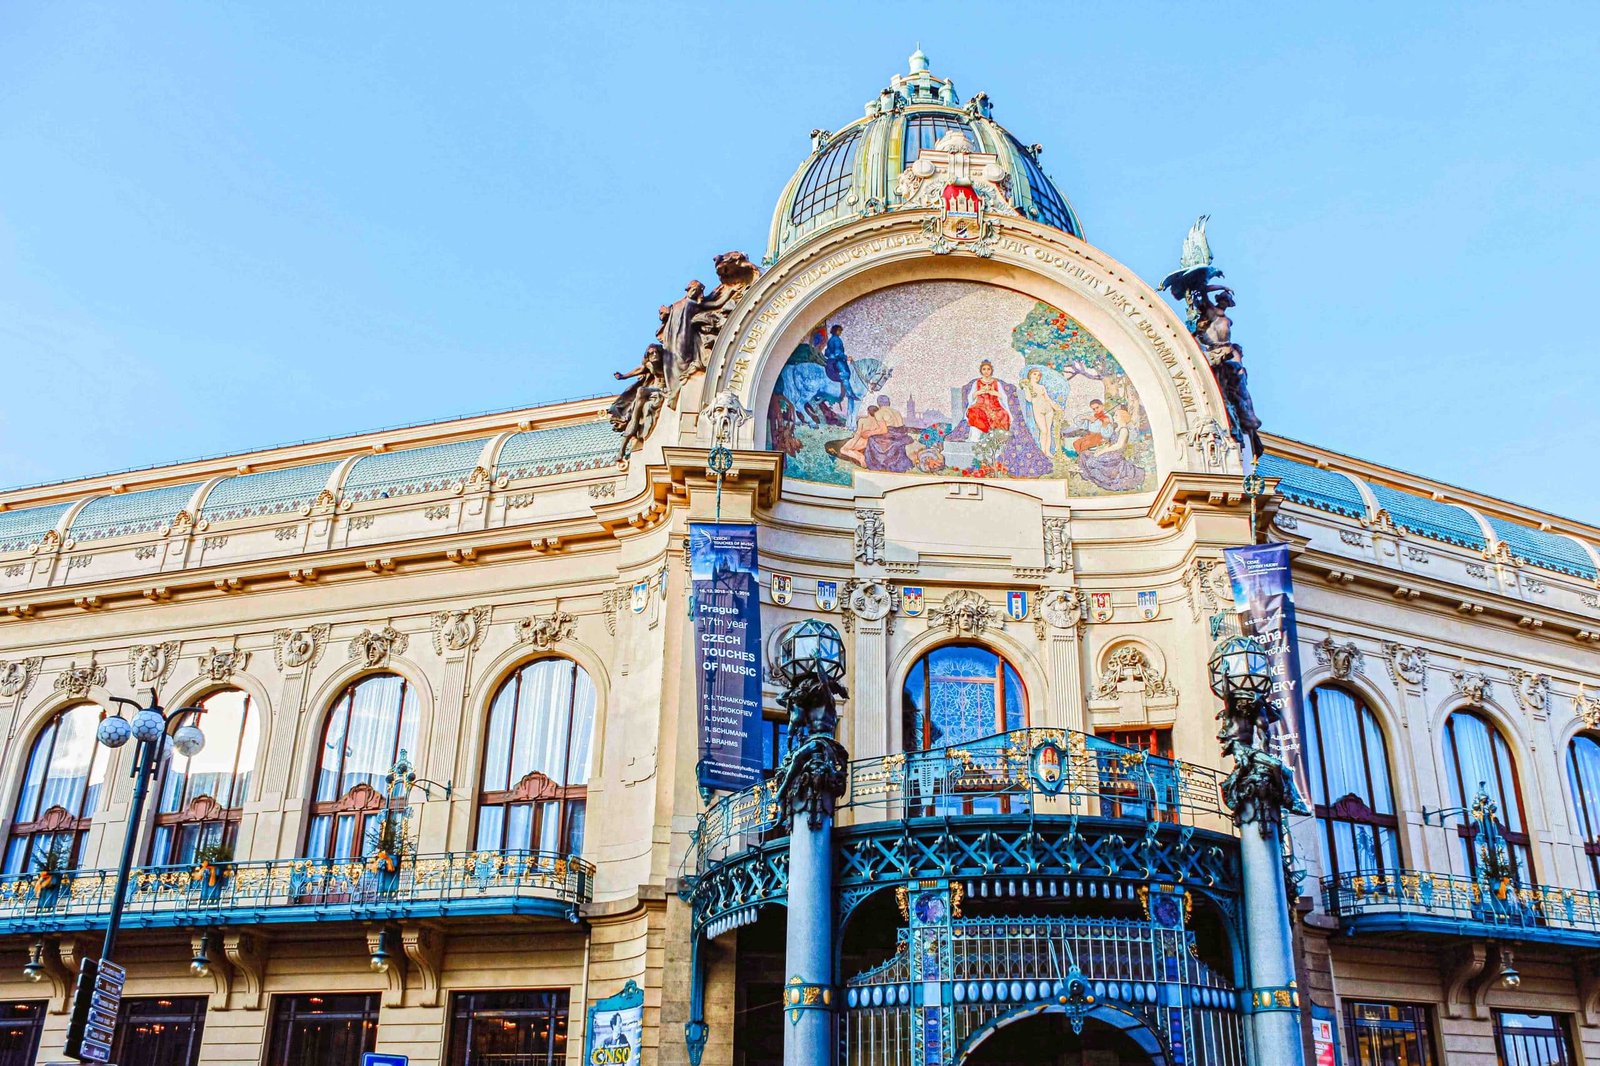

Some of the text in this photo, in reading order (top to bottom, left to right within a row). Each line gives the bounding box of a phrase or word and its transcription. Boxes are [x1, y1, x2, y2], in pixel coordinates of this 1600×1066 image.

[1001, 239, 1030, 255] JAK
[700, 604, 739, 615] Prague
[701, 616, 749, 629] 17th year
[701, 633, 741, 645] CZECH
[702, 647, 756, 662] TOUCHES
[702, 661, 757, 677] OF MUSIC
[715, 695, 758, 708] TCHAIKOVSKY
[718, 706, 753, 717] PROKOFIEV
[712, 715, 738, 725] DVOŘÁK
[712, 727, 748, 739] SCHUMANN
[711, 738, 739, 748] BRAHMS
